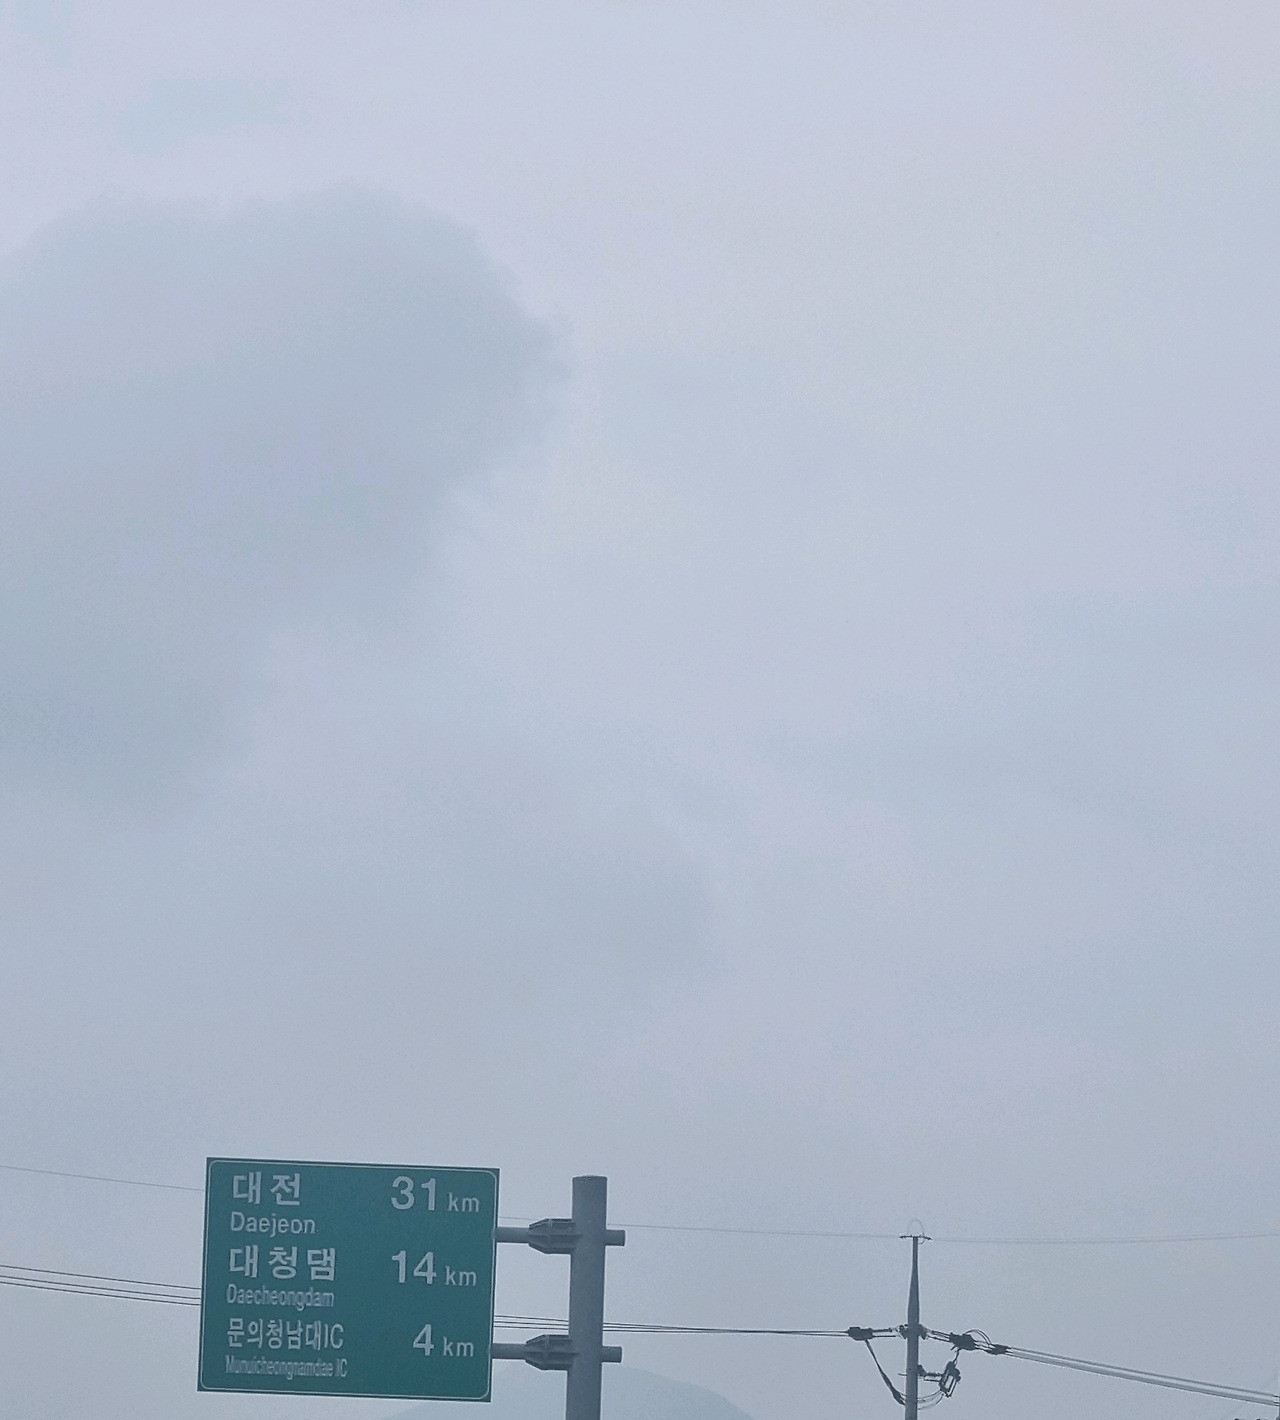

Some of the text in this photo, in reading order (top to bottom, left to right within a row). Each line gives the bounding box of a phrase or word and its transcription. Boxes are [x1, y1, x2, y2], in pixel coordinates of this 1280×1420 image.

[232, 1172, 301, 1206] 대전
[391, 1176, 480, 1213] 31 km
[230, 1211, 316, 1237] Daejeon
[229, 1245, 336, 1281] 대청댐
[391, 1250, 477, 1287] 14 km
[226, 1283, 335, 1311] Daecheongdam
[226, 1318, 345, 1351] 문의청남대IC
[412, 1324, 475, 1357] 4 km
[336, 1358, 348, 1378] IC
